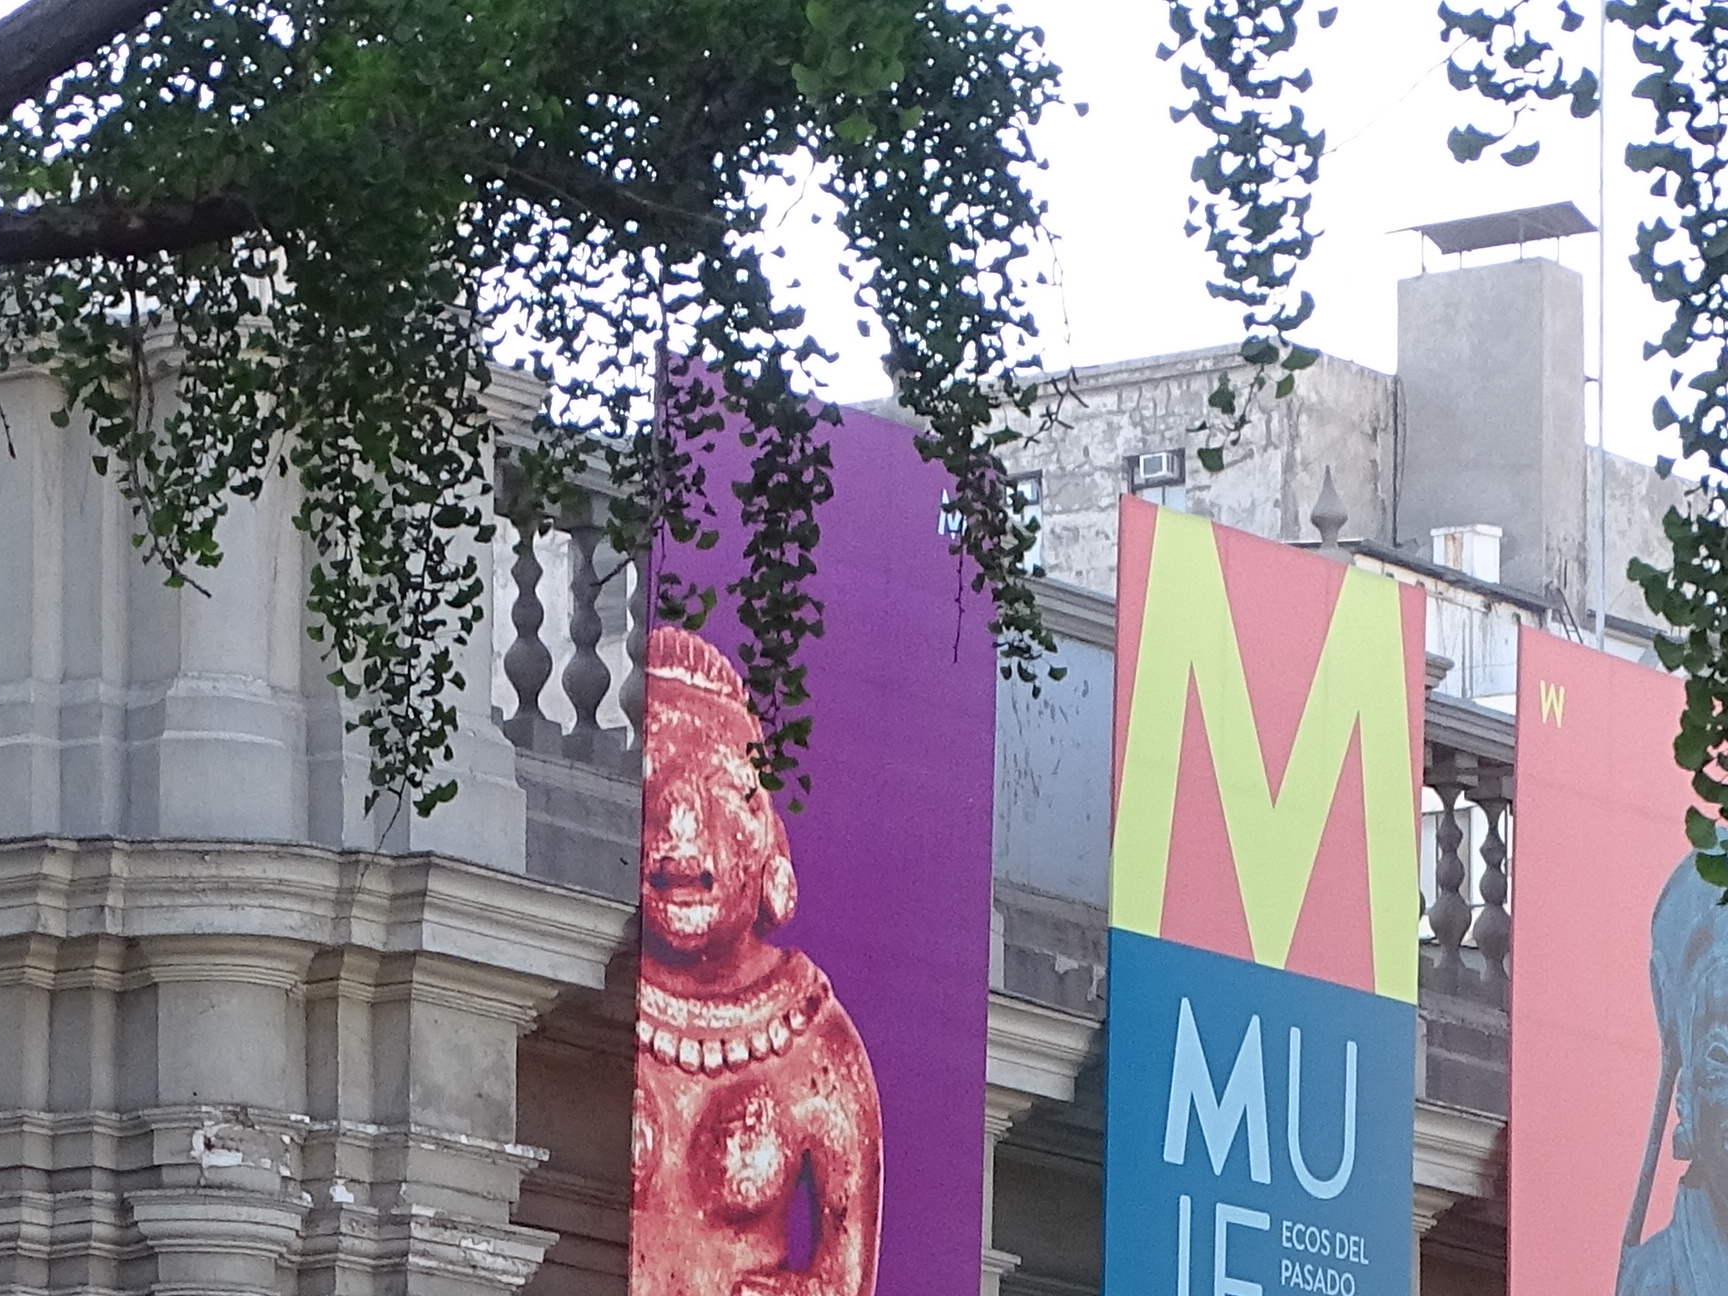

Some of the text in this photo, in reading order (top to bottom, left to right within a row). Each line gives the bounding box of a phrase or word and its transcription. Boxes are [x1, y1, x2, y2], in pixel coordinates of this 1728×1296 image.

[1540, 680, 1565, 728] W
[1163, 996, 1358, 1199] MU
[1281, 1221, 1370, 1265] ECOS DEL
